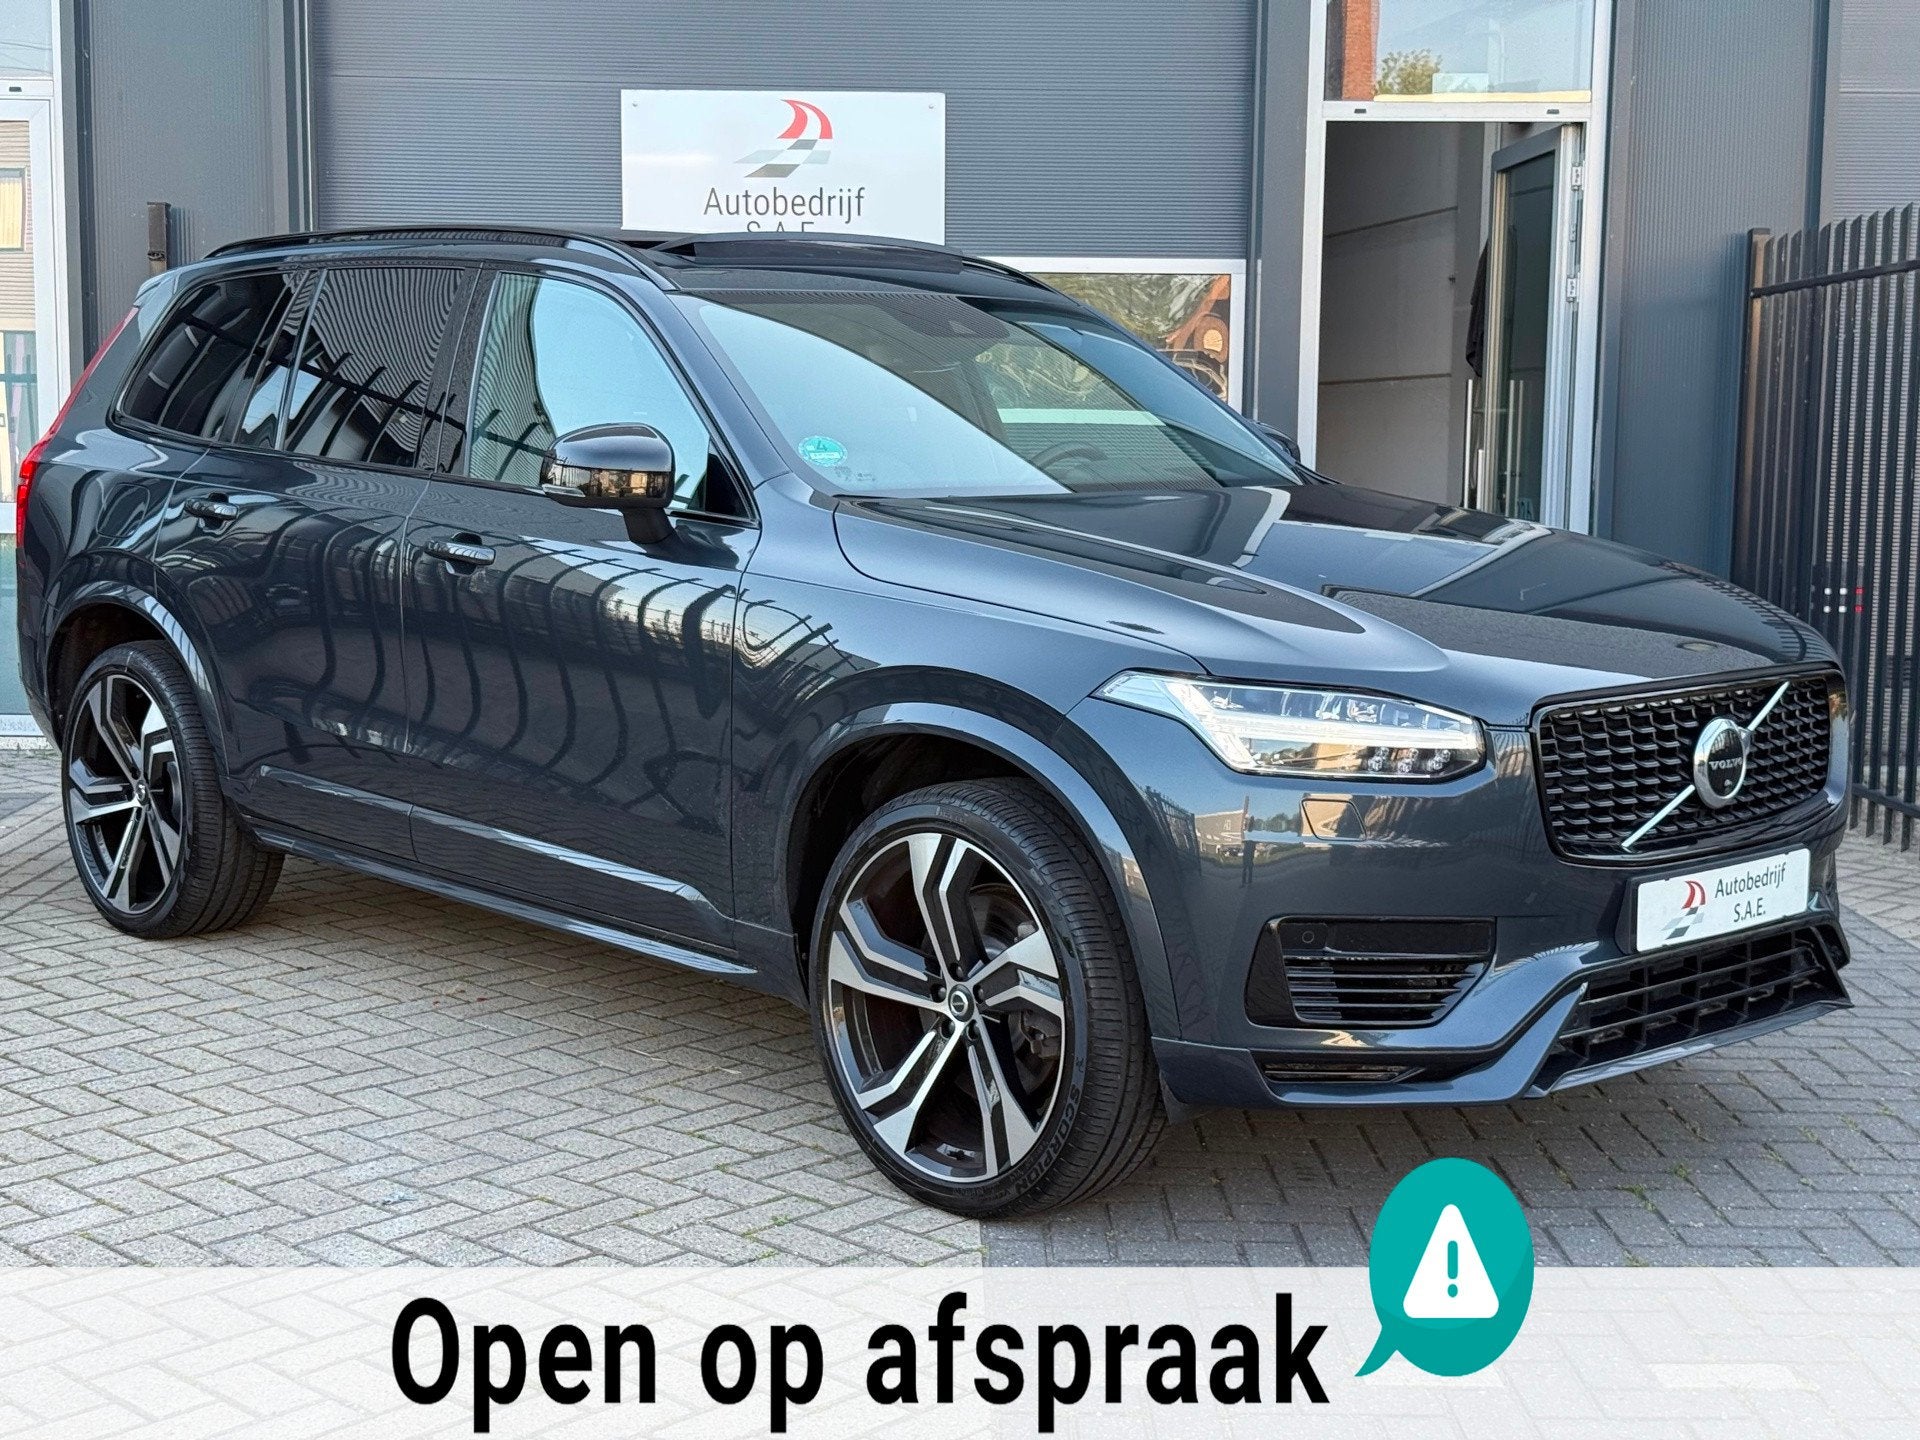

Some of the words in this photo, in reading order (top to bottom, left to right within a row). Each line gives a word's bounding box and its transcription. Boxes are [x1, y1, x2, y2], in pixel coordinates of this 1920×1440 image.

[703, 186, 866, 225] Autobedrijf
[1709, 757, 1743, 770] VOLVO
[1714, 861, 1787, 899] Autobedrijf
[1733, 897, 1766, 923] S.A.E.
